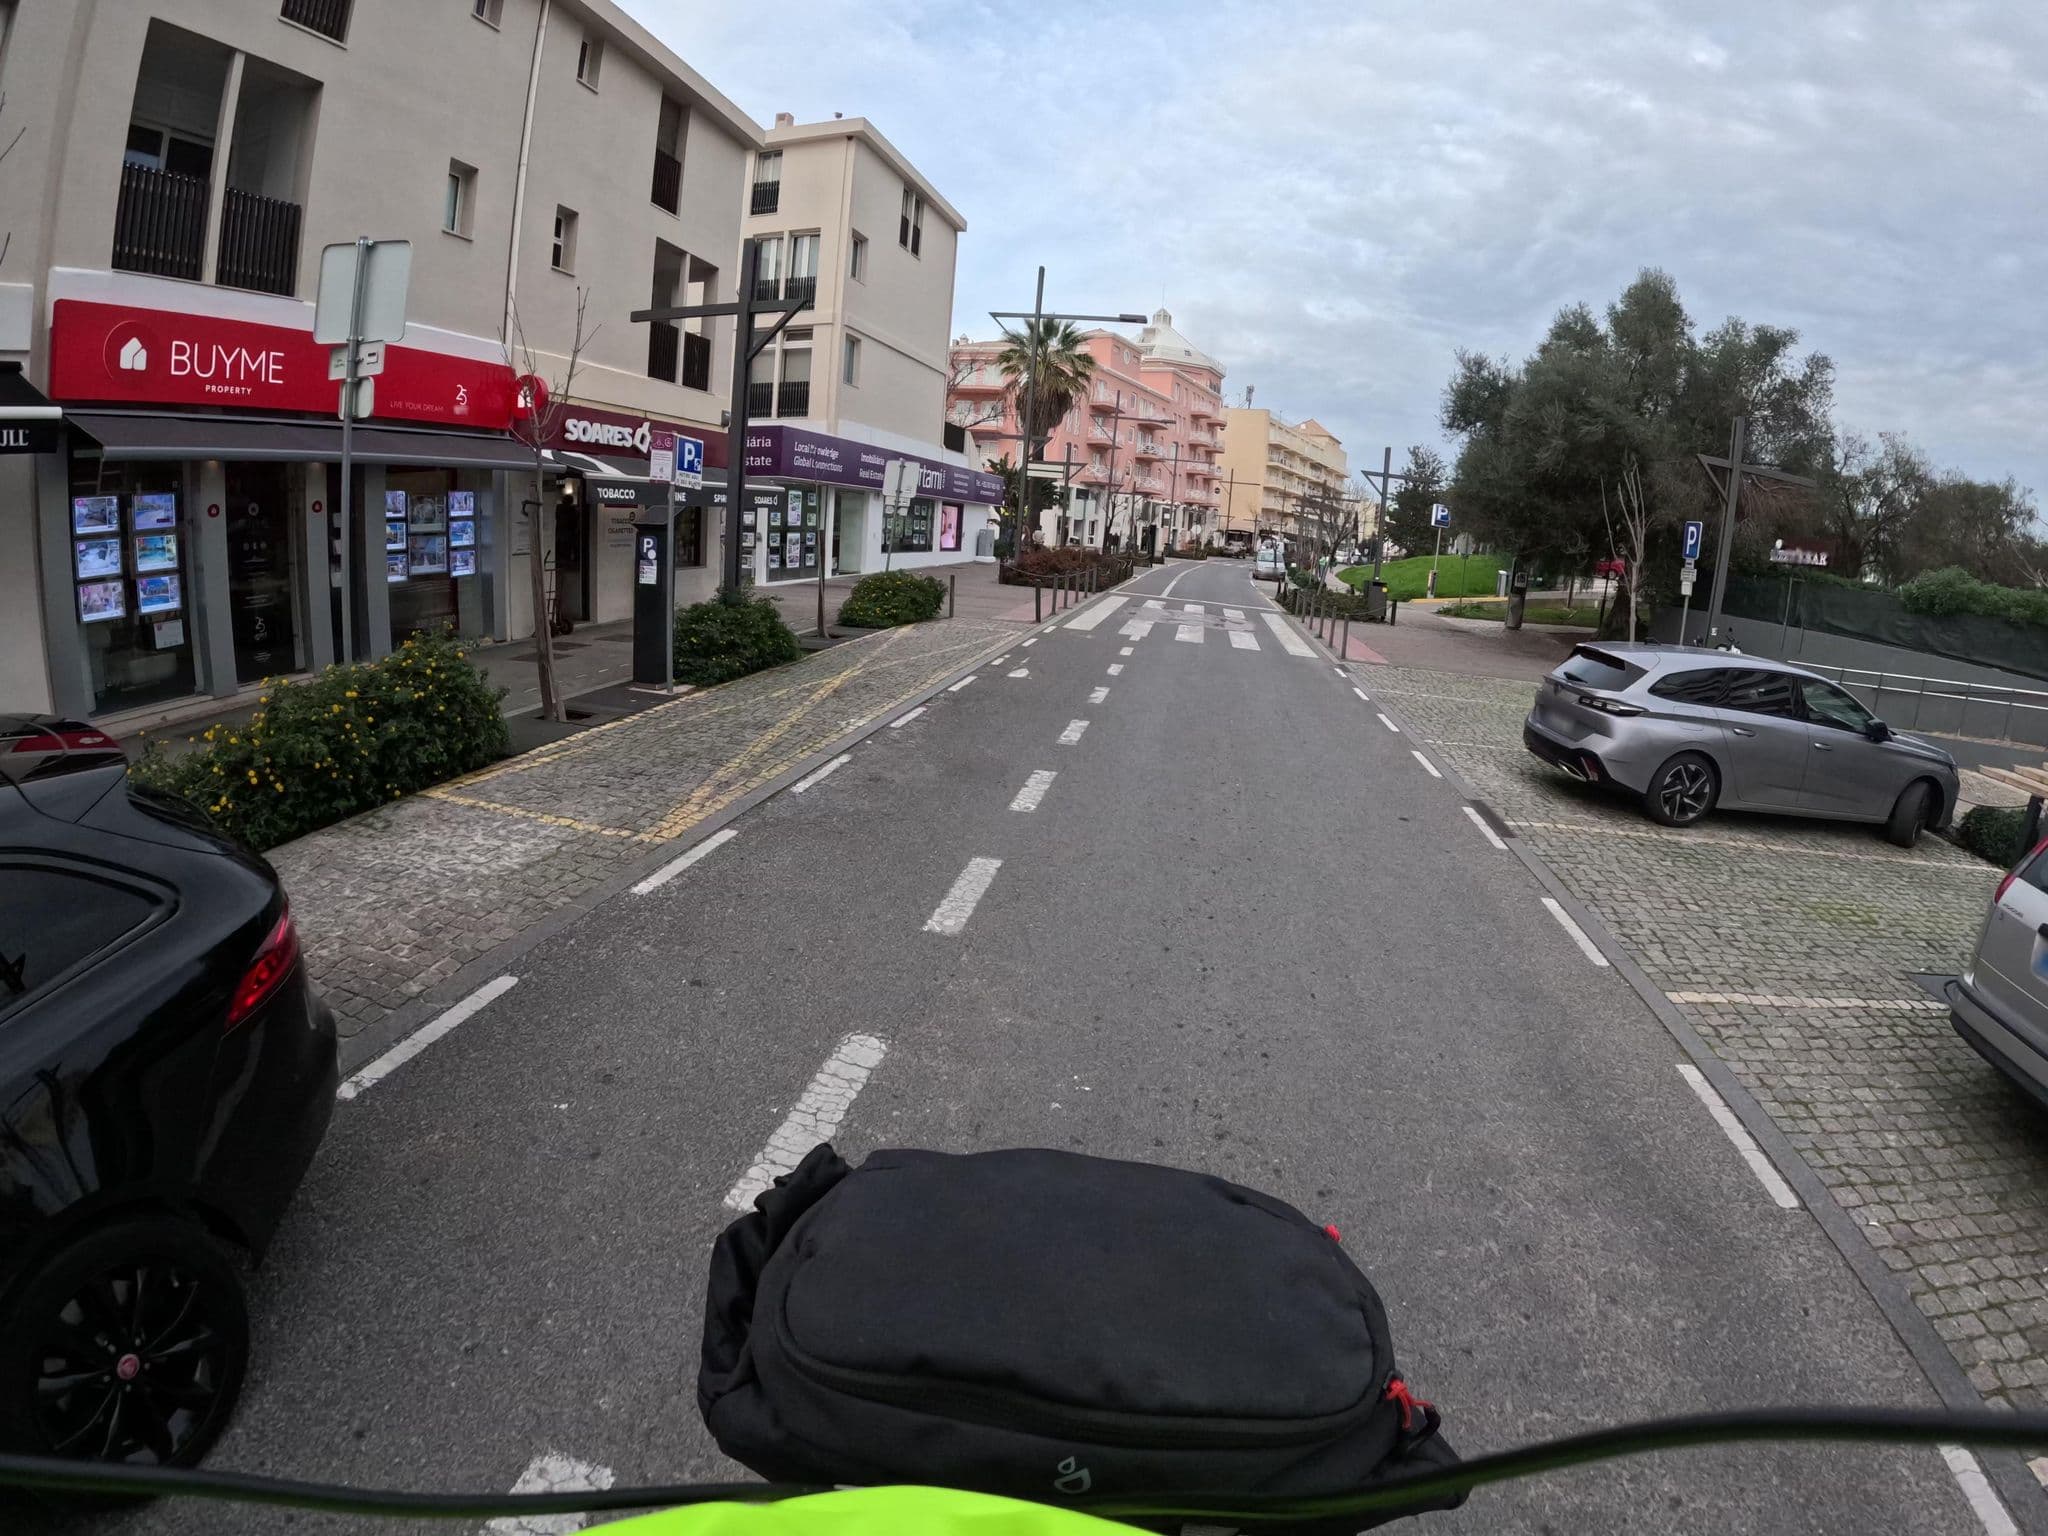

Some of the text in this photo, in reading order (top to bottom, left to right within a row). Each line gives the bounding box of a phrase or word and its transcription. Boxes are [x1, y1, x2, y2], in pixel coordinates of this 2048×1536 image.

[170, 340, 285, 384] BUYME
[205, 384, 252, 395] PROPERTY
[455, 384, 468, 406] 25
[564, 418, 634, 448] SOARES
[794, 441, 810, 454] Local
[684, 442, 696, 469] P
[745, 455, 773, 466] state
[793, 455, 811, 468] Global
[597, 487, 635, 500] TOBACCO
[674, 492, 687, 502] INE
[754, 496, 773, 505] SOARES
[1436, 506, 1449, 520] P
[643, 538, 653, 553] P
[1686, 526, 1697, 554] P
